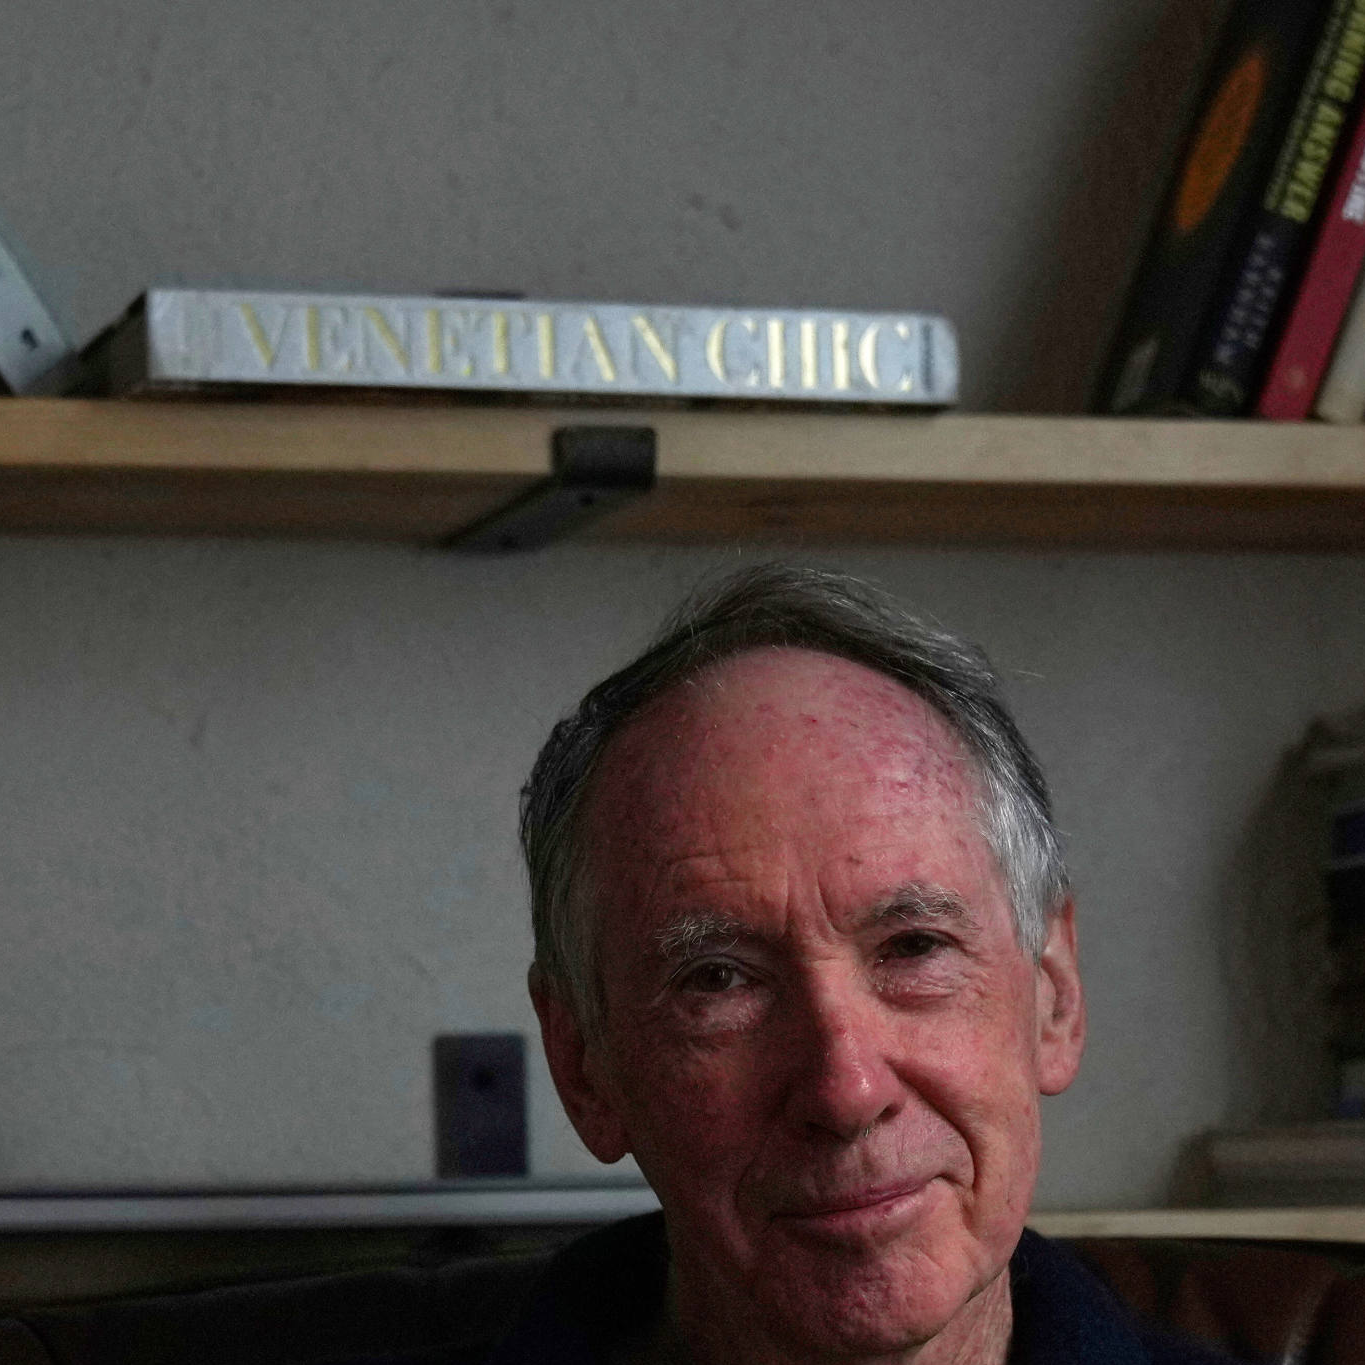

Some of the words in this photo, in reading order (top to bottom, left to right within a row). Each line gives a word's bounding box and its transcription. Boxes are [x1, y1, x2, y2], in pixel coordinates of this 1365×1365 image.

[1280, 102, 1345, 224] ANSWER
[238, 300, 679, 385] VENETIAN
[706, 317, 914, 394] CHIC
